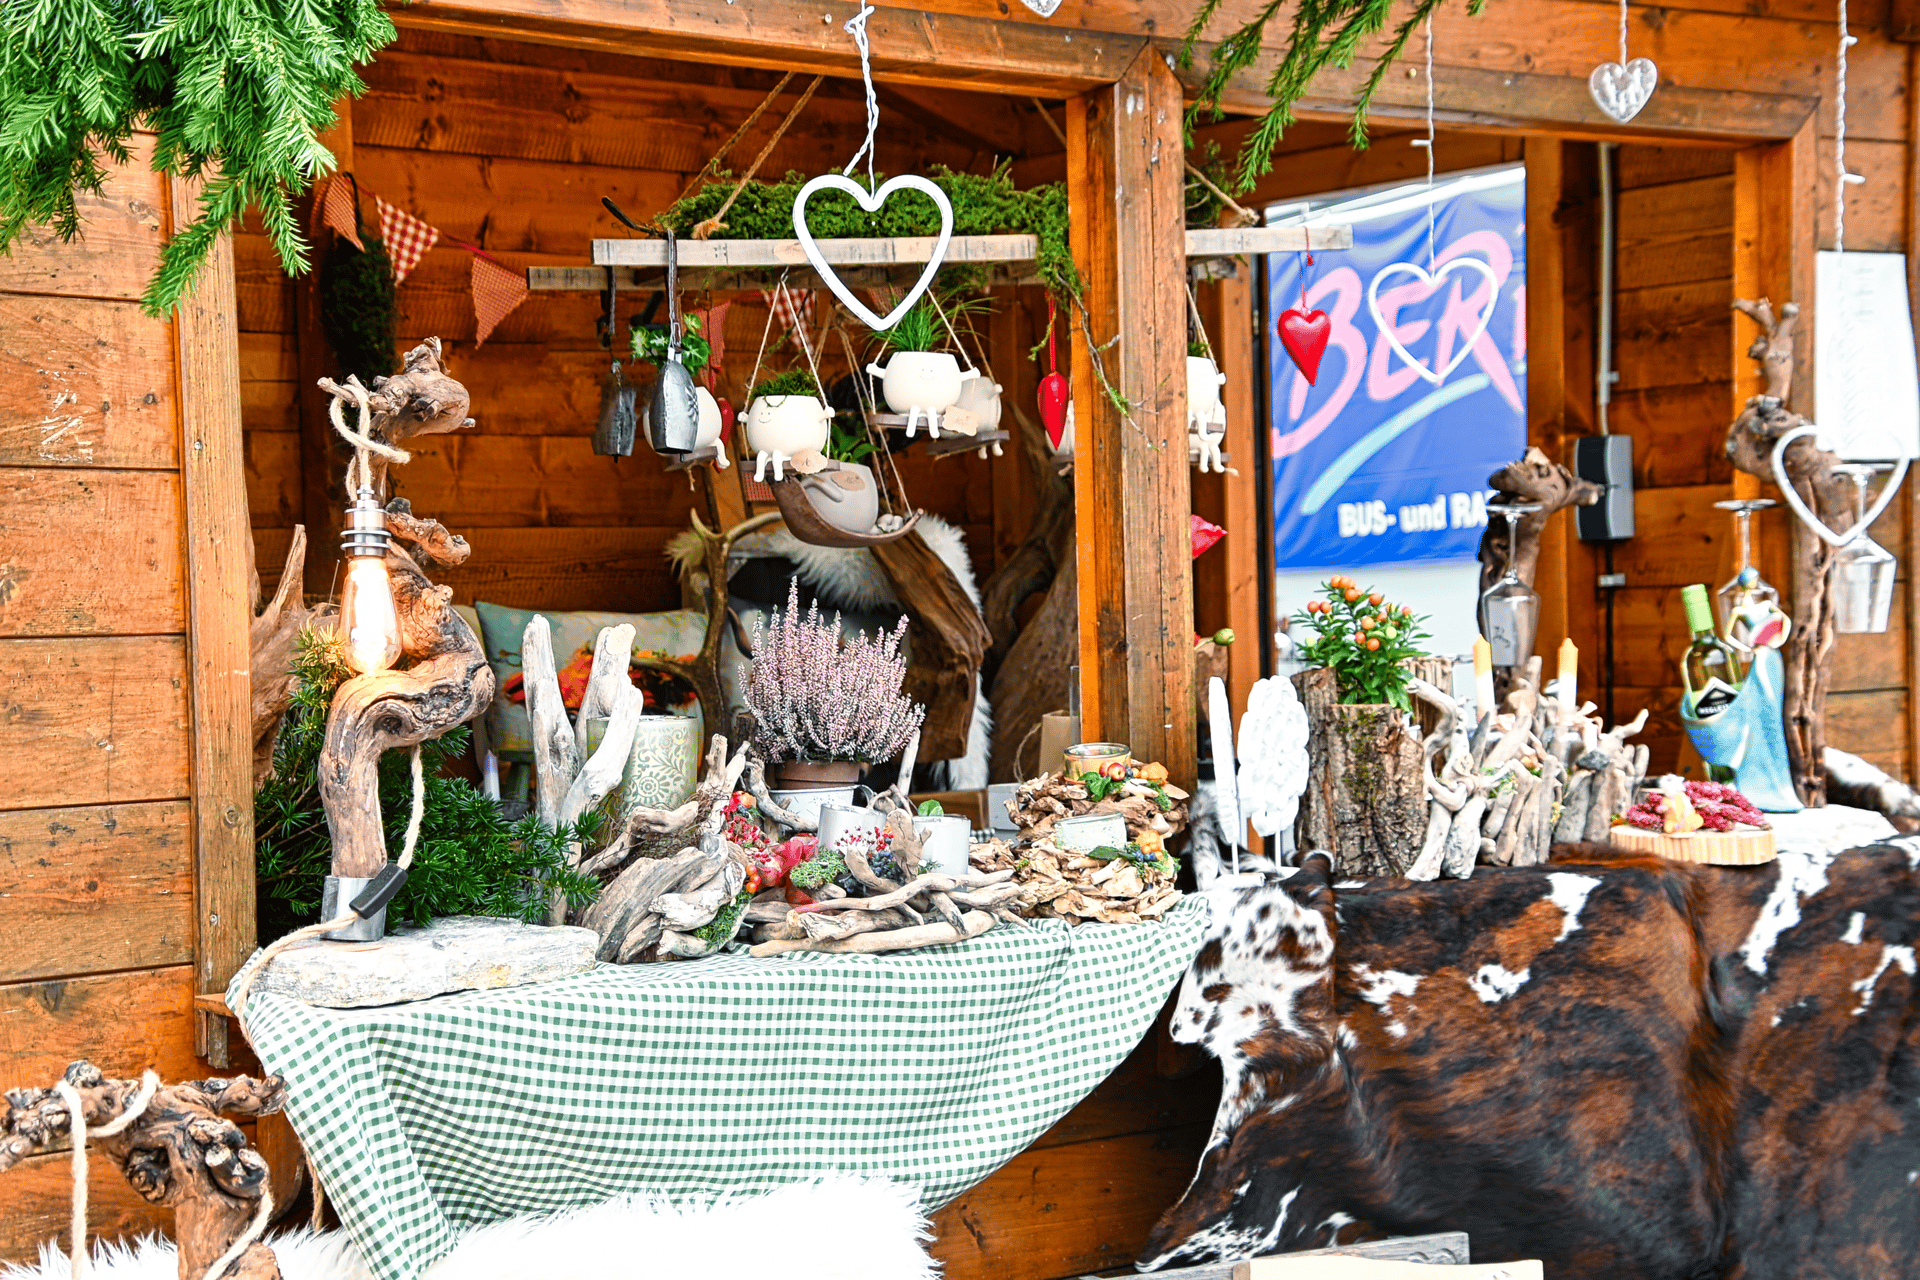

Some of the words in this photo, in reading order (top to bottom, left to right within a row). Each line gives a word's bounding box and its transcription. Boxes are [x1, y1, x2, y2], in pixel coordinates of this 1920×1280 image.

[1272, 228, 1526, 459] BER
[1338, 499, 1397, 538] BUS-
[1399, 494, 1448, 533] und
[1450, 490, 1500, 529] RA
